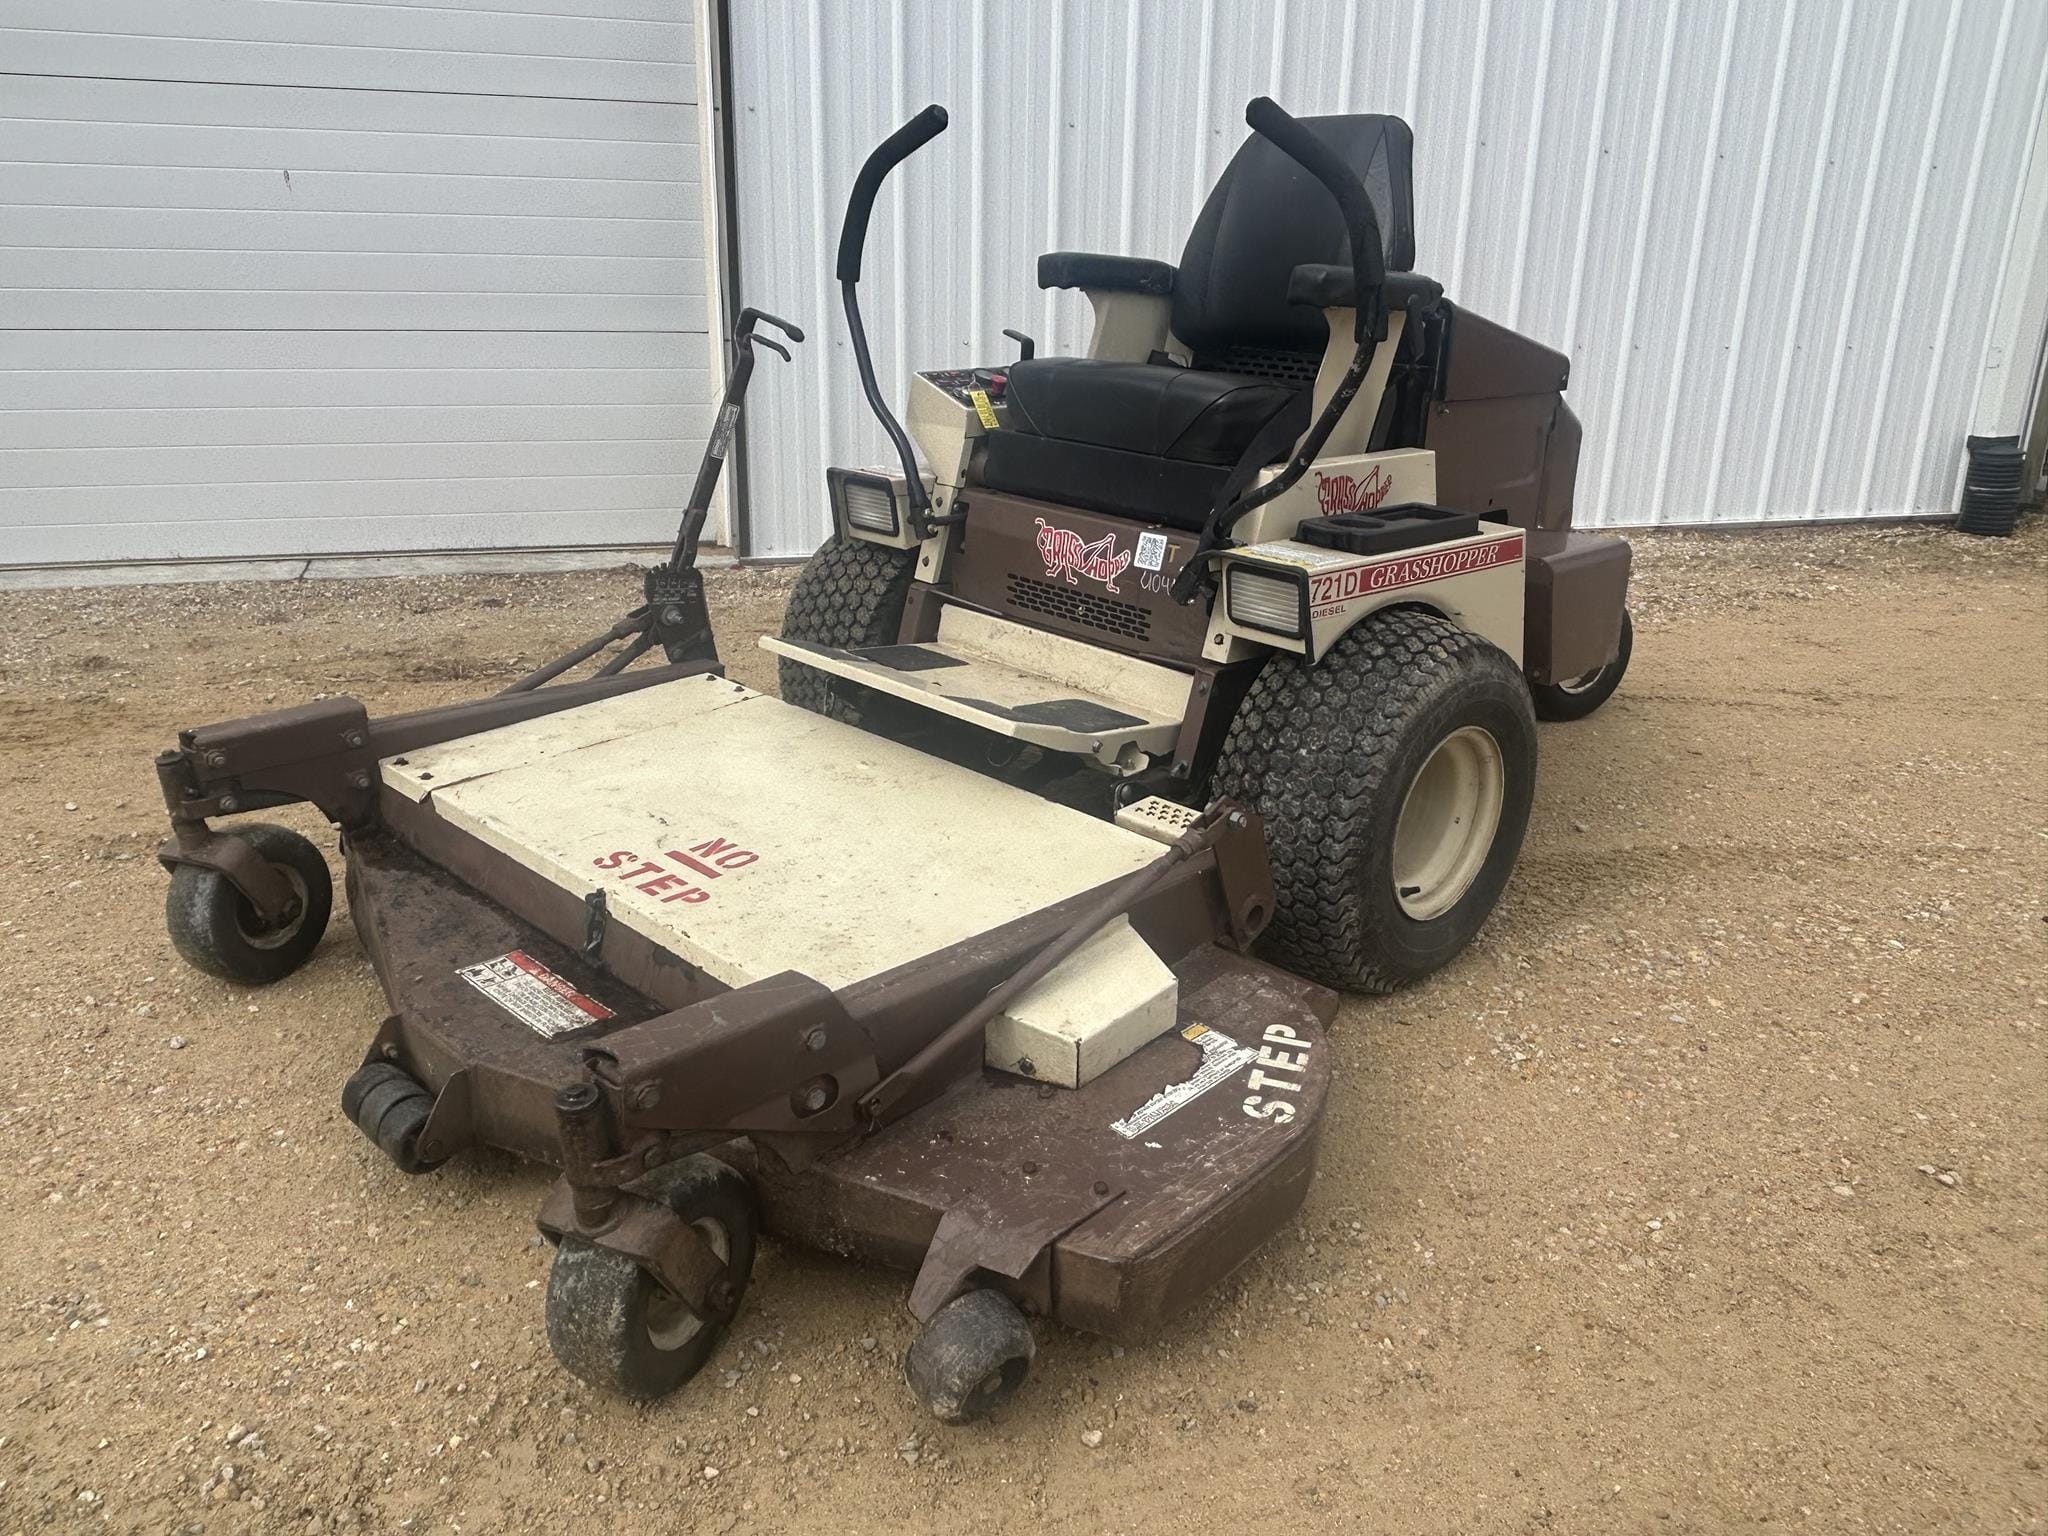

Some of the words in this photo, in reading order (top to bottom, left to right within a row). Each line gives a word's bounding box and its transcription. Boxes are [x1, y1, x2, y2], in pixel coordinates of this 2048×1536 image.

[1311, 571, 1358, 604] 721D
[1370, 545, 1500, 588] GRASSHOPPER
[1312, 604, 1346, 619] DIESEL
[592, 850, 711, 904] STEP
[688, 837, 760, 870] NO
[1242, 1023, 1312, 1124] STEP
